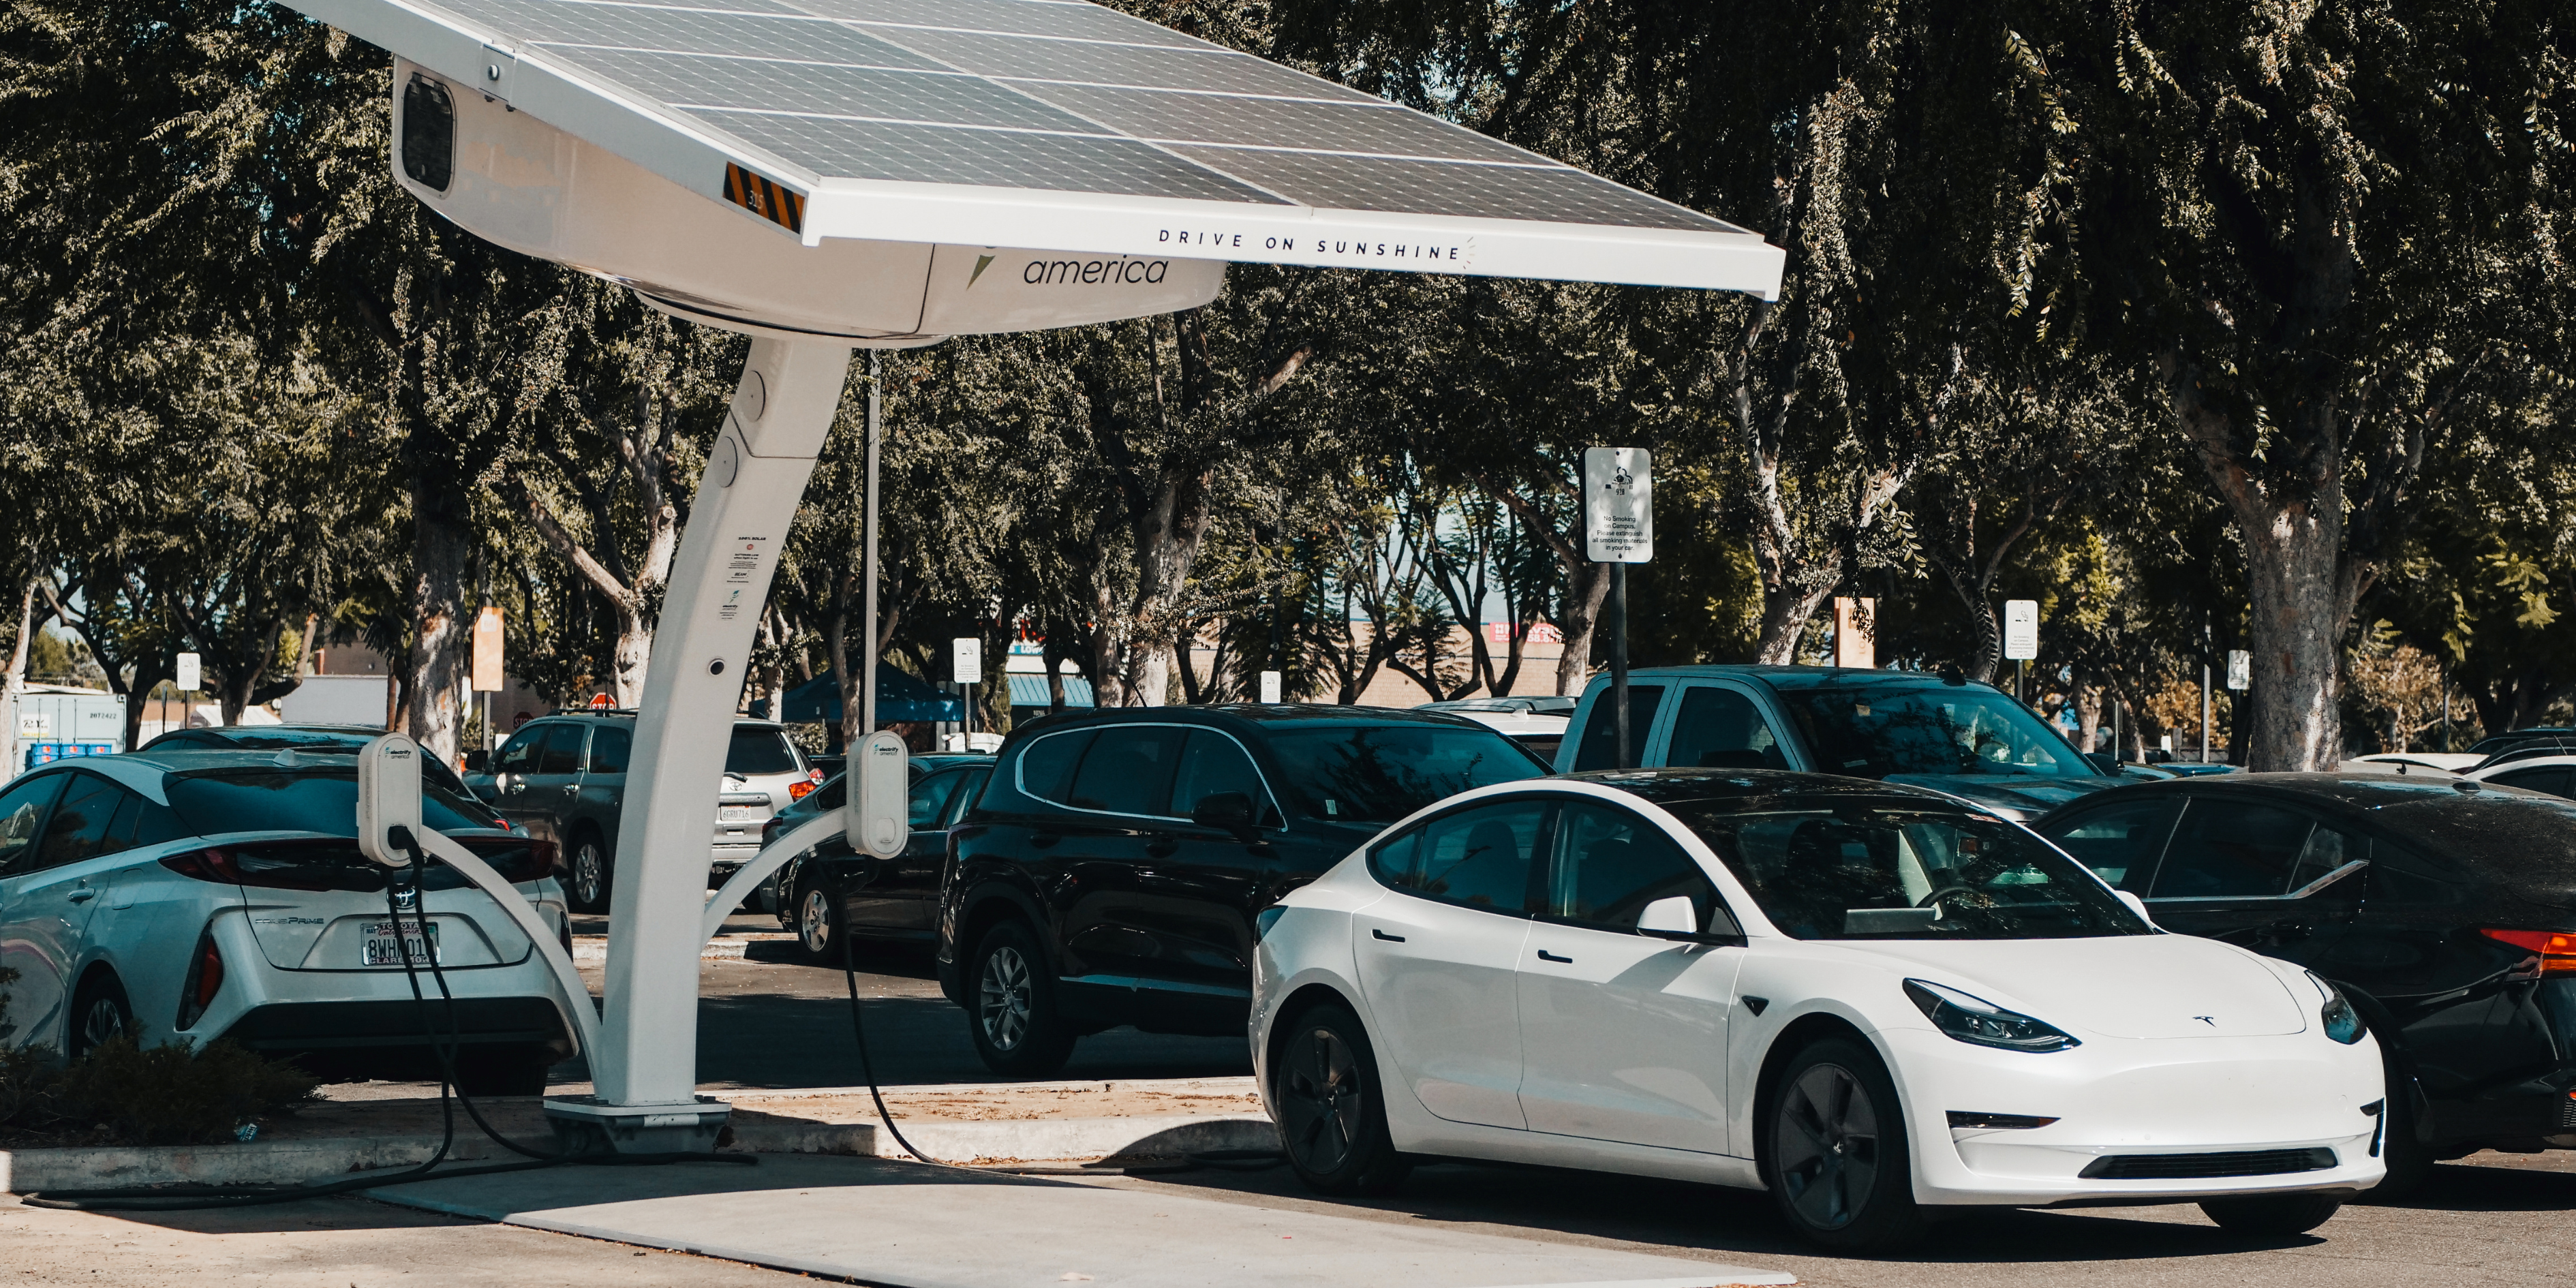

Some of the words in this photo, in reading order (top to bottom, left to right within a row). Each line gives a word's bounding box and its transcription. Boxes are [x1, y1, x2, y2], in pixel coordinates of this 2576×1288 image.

[1159, 230, 1242, 247] DRIVE
[1266, 237, 1293, 251] ON
[1317, 240, 1458, 260] SUNSHINE
[1024, 254, 1169, 284] america
[723, 810, 749, 818] 6GRU716
